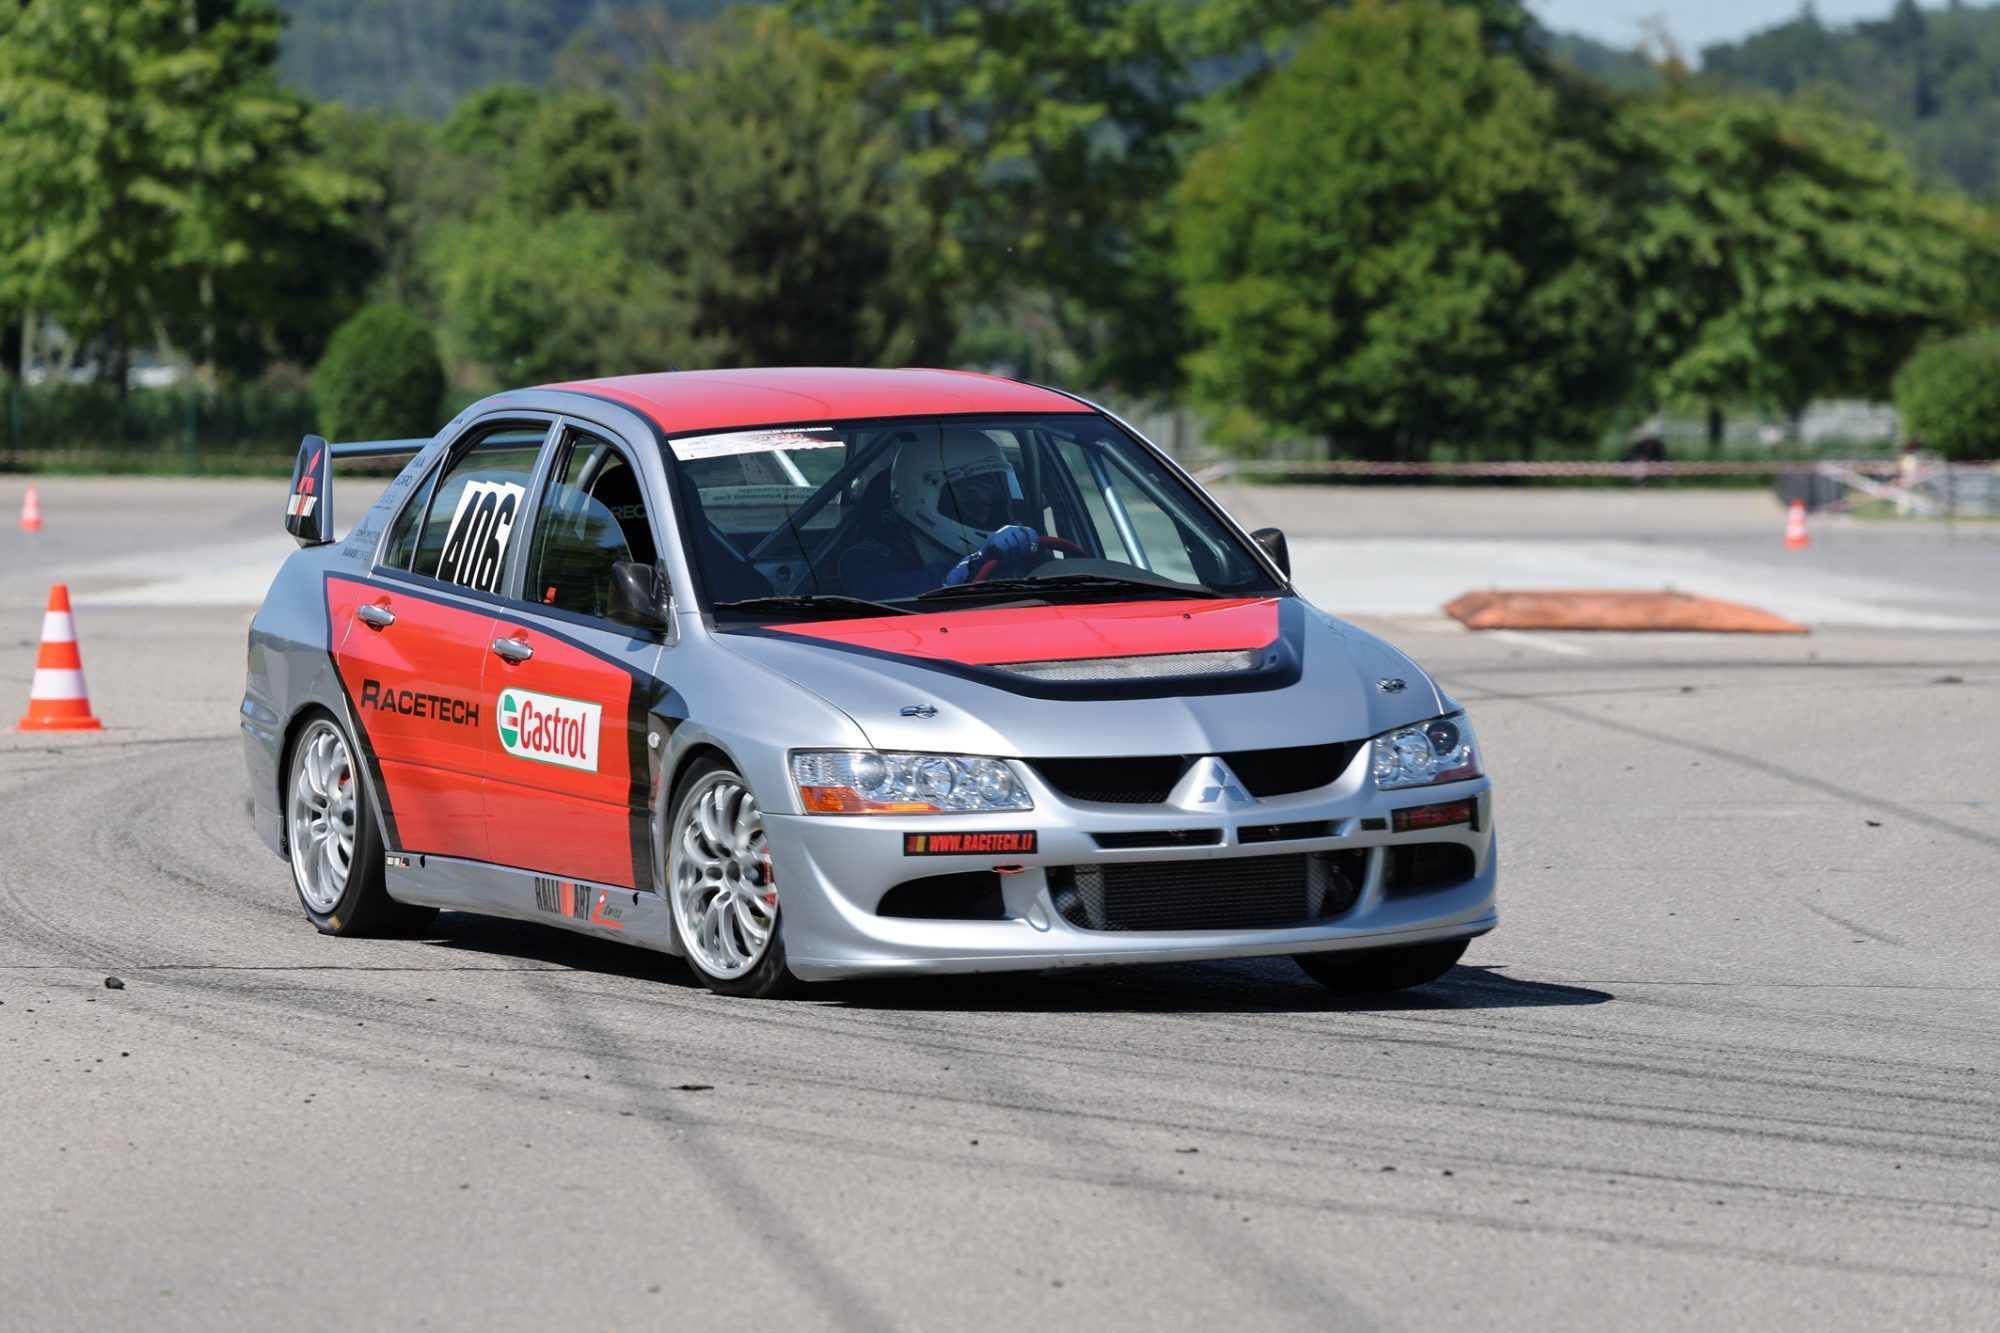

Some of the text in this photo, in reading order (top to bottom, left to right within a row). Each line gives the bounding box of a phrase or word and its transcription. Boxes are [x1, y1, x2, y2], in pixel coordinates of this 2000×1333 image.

[612, 504, 646, 519] REC
[437, 490, 517, 593] 406
[360, 679, 479, 727] RACETECH
[520, 700, 587, 759] Castrol
